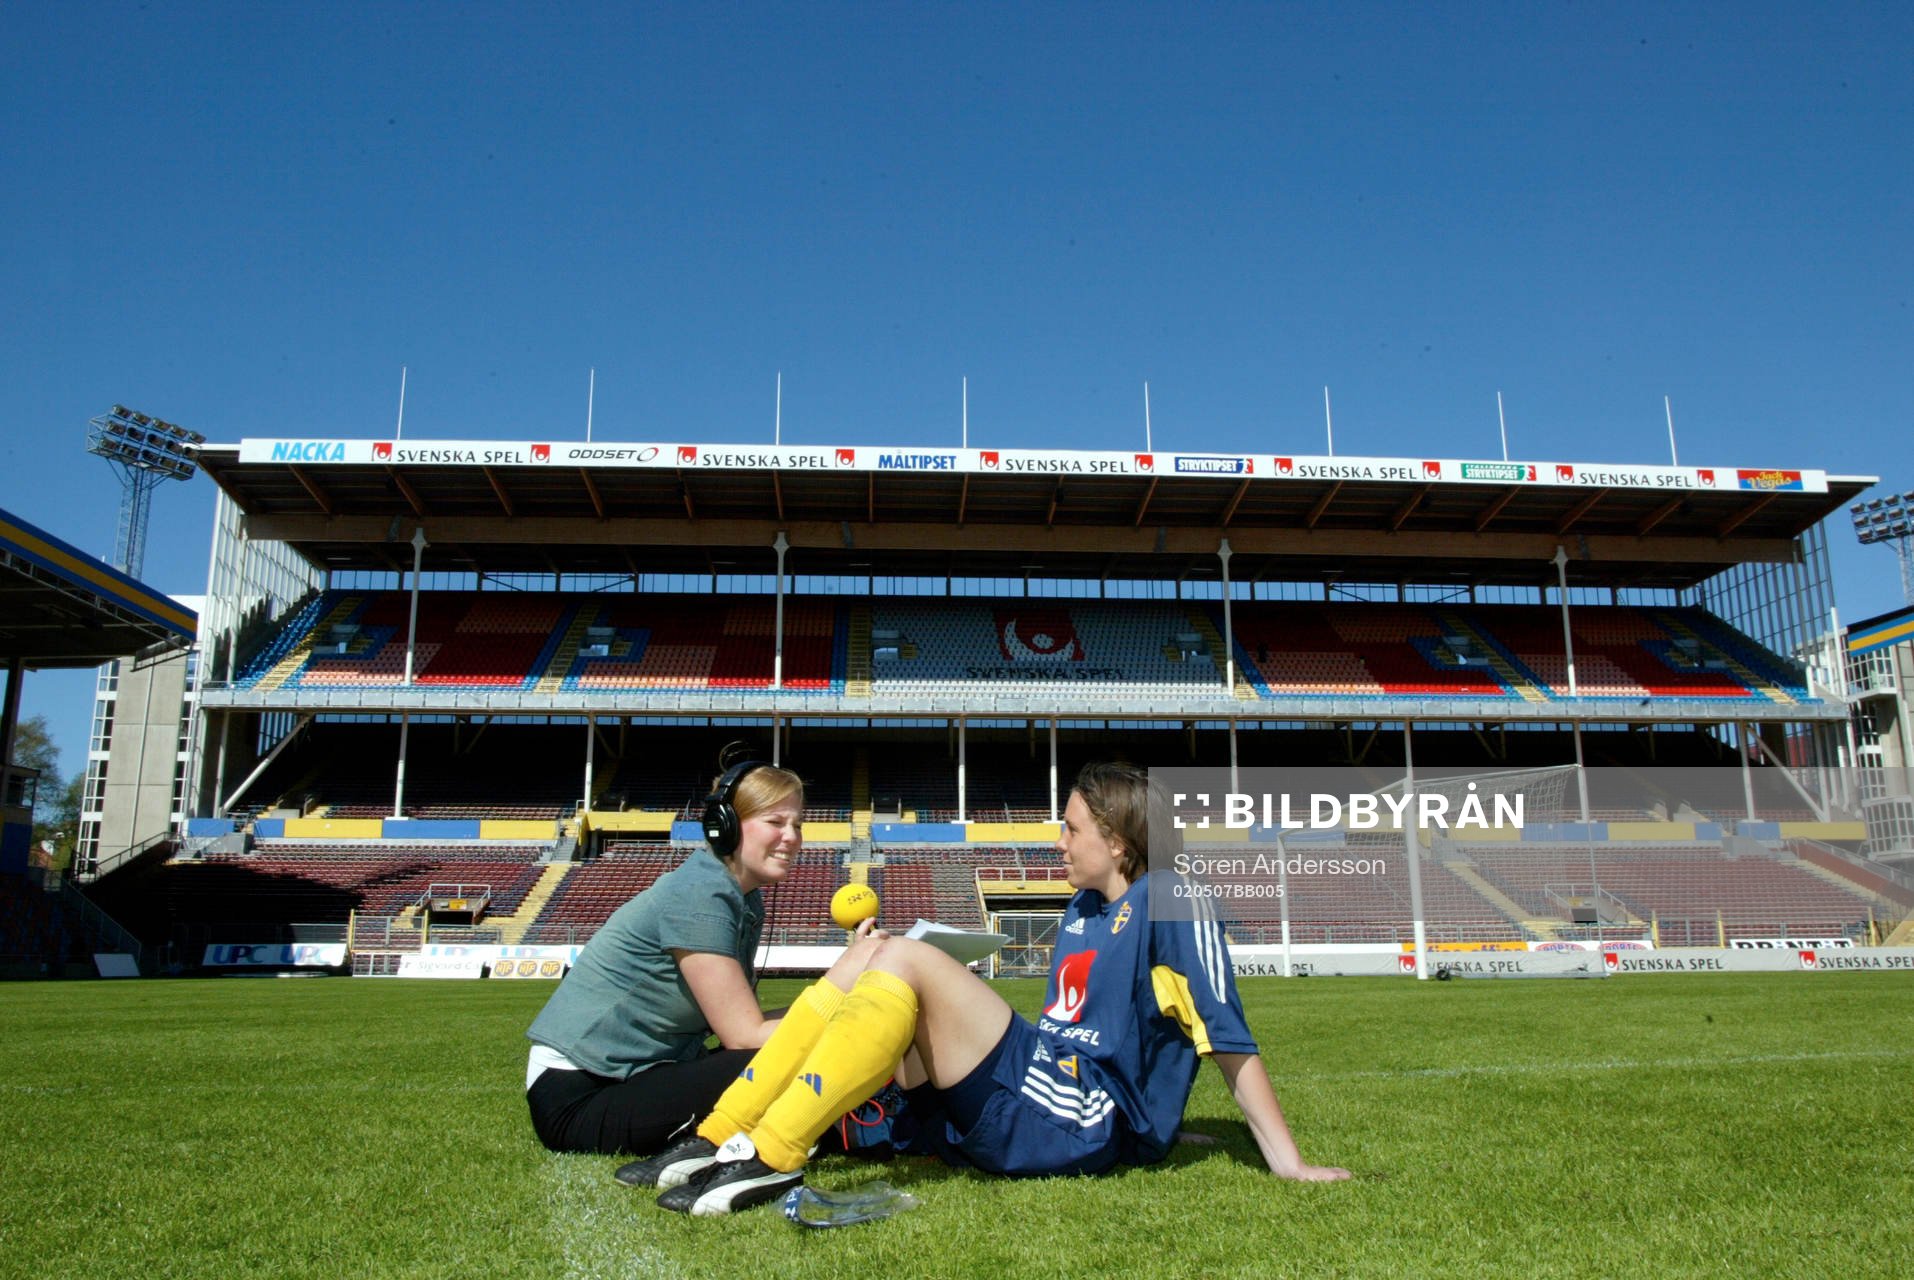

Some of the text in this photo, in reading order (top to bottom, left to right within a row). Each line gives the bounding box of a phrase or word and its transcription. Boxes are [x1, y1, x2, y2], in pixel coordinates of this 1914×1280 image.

[271, 442, 345, 461] NACKA
[397, 450, 523, 463] SVENSKA SPEL
[568, 449, 637, 459] ODDSET
[702, 454, 828, 468] SVENSKA SPEL
[1005, 459, 1129, 473] SVENSKA SPEL
[1299, 465, 1417, 479] SVENSKA SPEL
[1580, 472, 1692, 487] SVENSKA SPEL
[966, 667, 1068, 679] SVENSKA
[212, 946, 267, 964] UPC
[1231, 963, 1277, 975] ENSKA
[1489, 960, 1523, 973] SPEL
[1622, 958, 1724, 971] SVENSKA SPEL
[1821, 956, 1914, 969] SVENSKA SPE
[1061, 1026, 1099, 1046] SPEL
